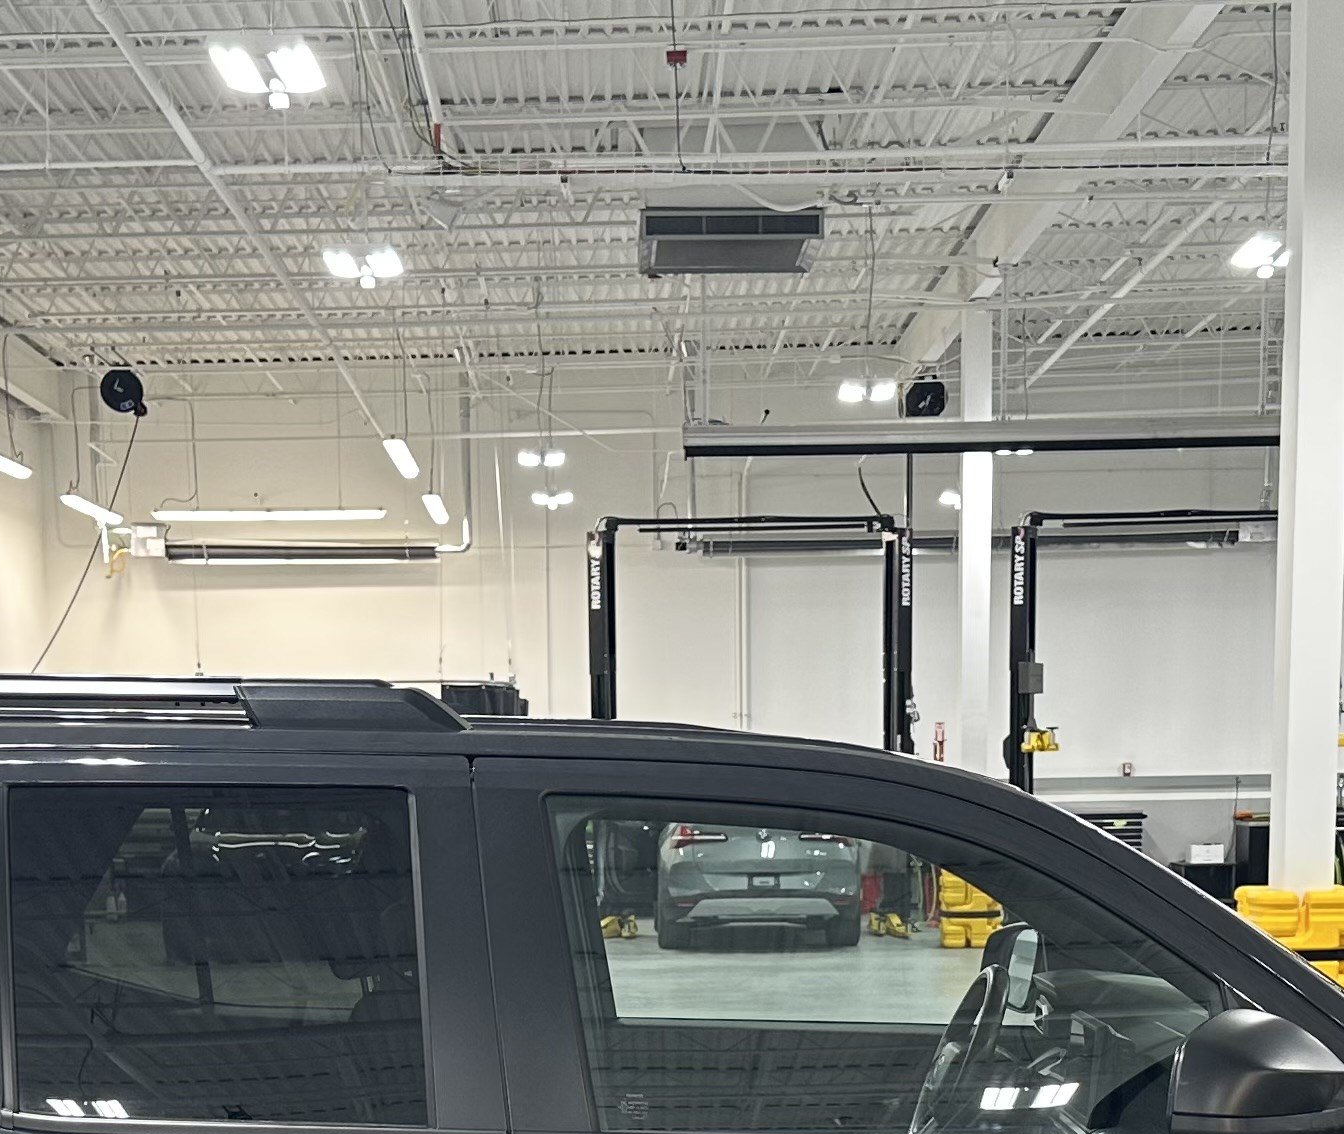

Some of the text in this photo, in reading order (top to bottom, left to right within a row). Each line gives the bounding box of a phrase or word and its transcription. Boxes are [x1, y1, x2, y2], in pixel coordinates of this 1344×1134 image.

[590, 558, 601, 609] ROTARY
[901, 555, 911, 606] ROTARY
[1013, 535, 1025, 605] ROTARY SP
